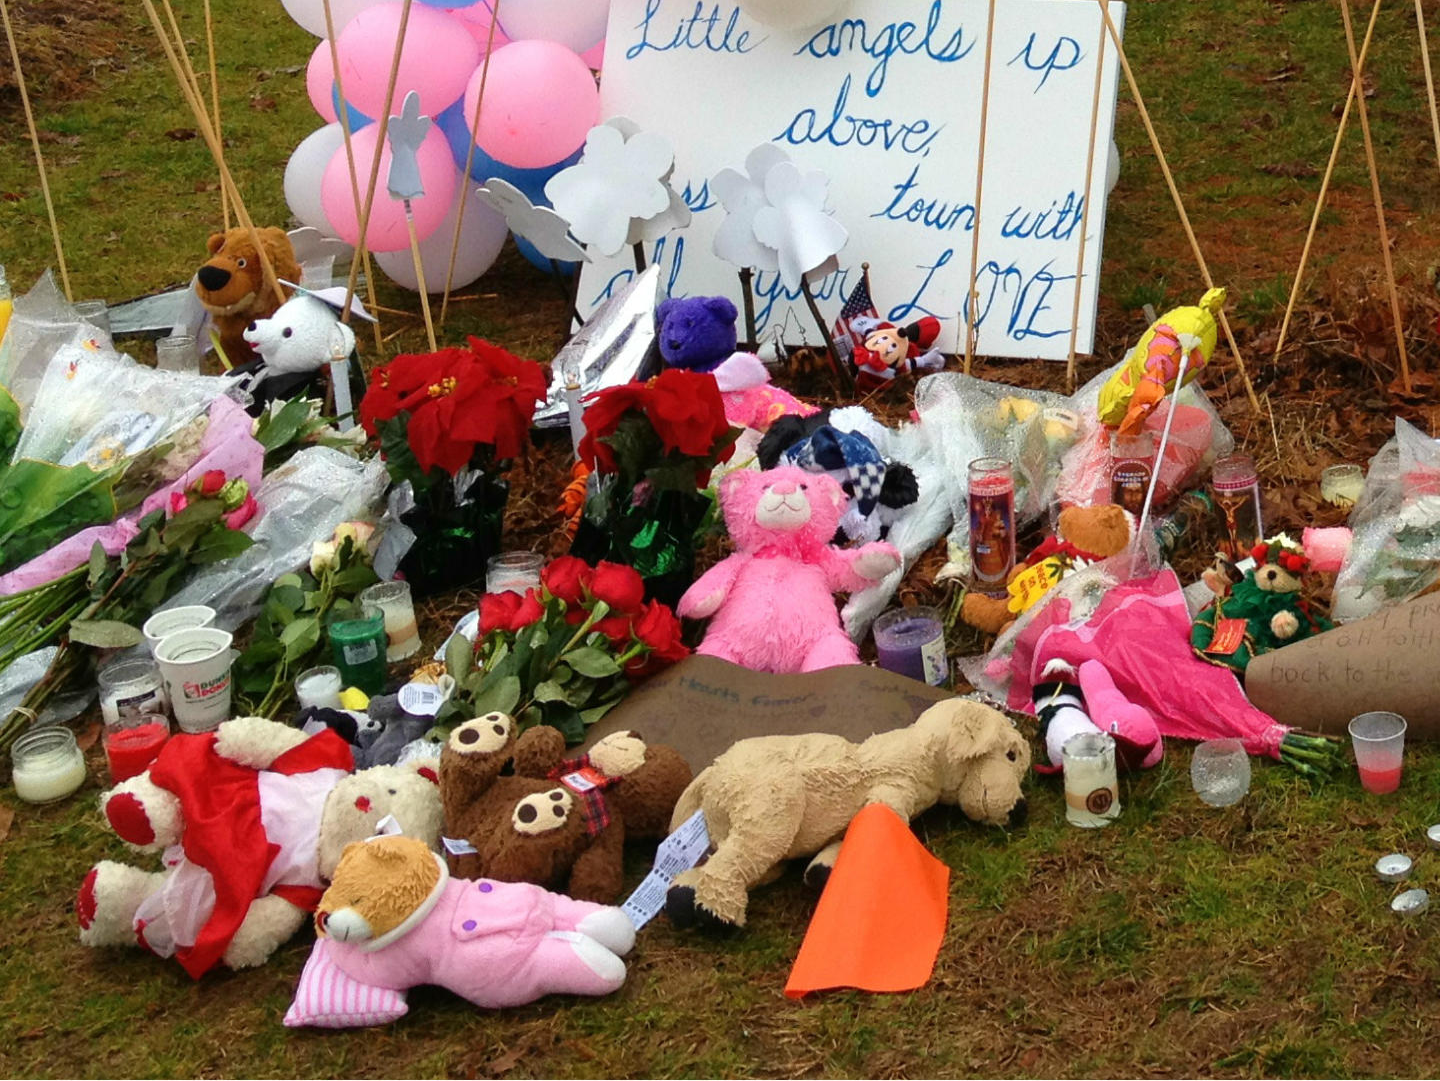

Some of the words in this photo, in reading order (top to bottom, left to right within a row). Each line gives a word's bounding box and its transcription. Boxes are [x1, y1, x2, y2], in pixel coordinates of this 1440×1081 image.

[1007, 31, 1086, 94] up
[772, 74, 948, 155] above,
[870, 163, 978, 232] town
[1001, 190, 1093, 242] with
[887, 248, 1088, 342] LOVE
